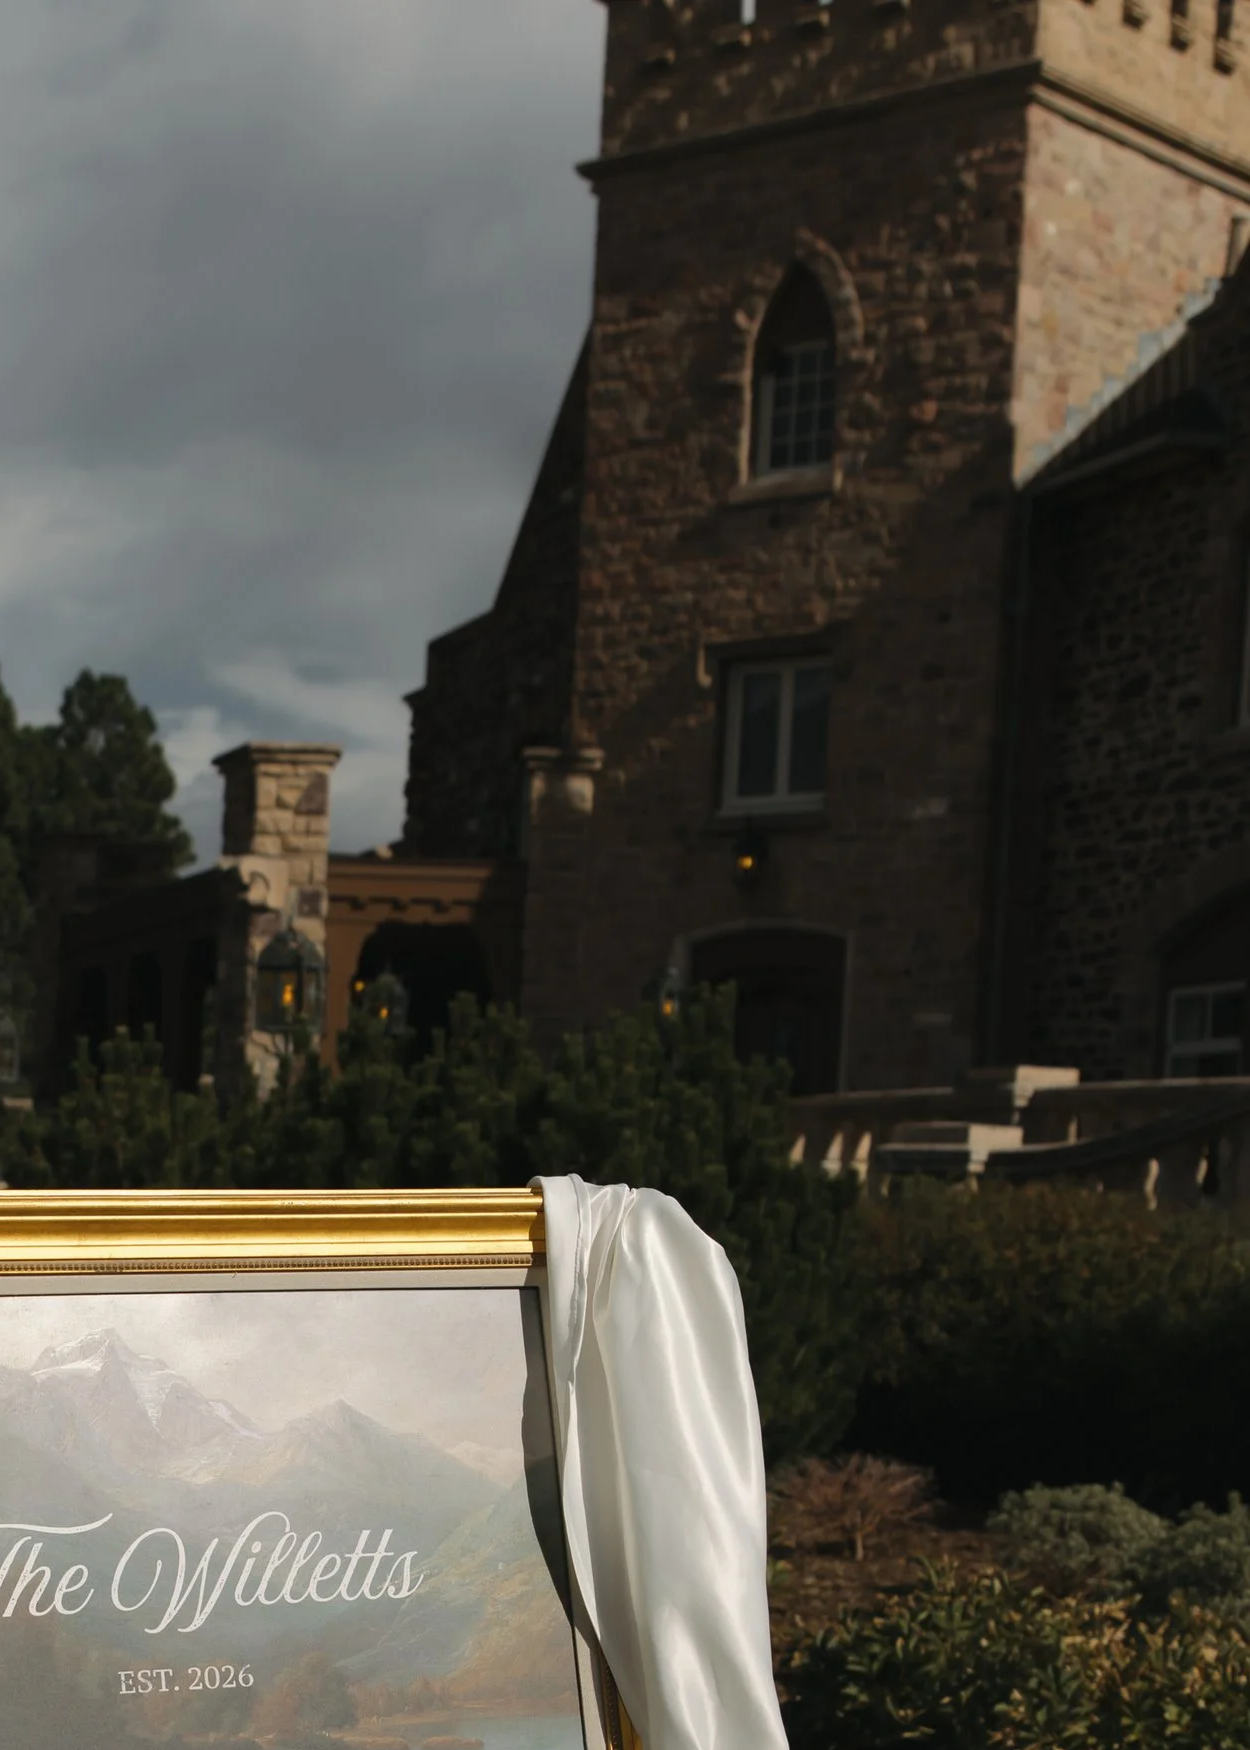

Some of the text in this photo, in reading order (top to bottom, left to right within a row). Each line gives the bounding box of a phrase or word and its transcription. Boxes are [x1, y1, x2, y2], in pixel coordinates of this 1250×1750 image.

[111, 1511, 425, 1634] Willetts
[118, 1664, 255, 1695] EST. 2026
